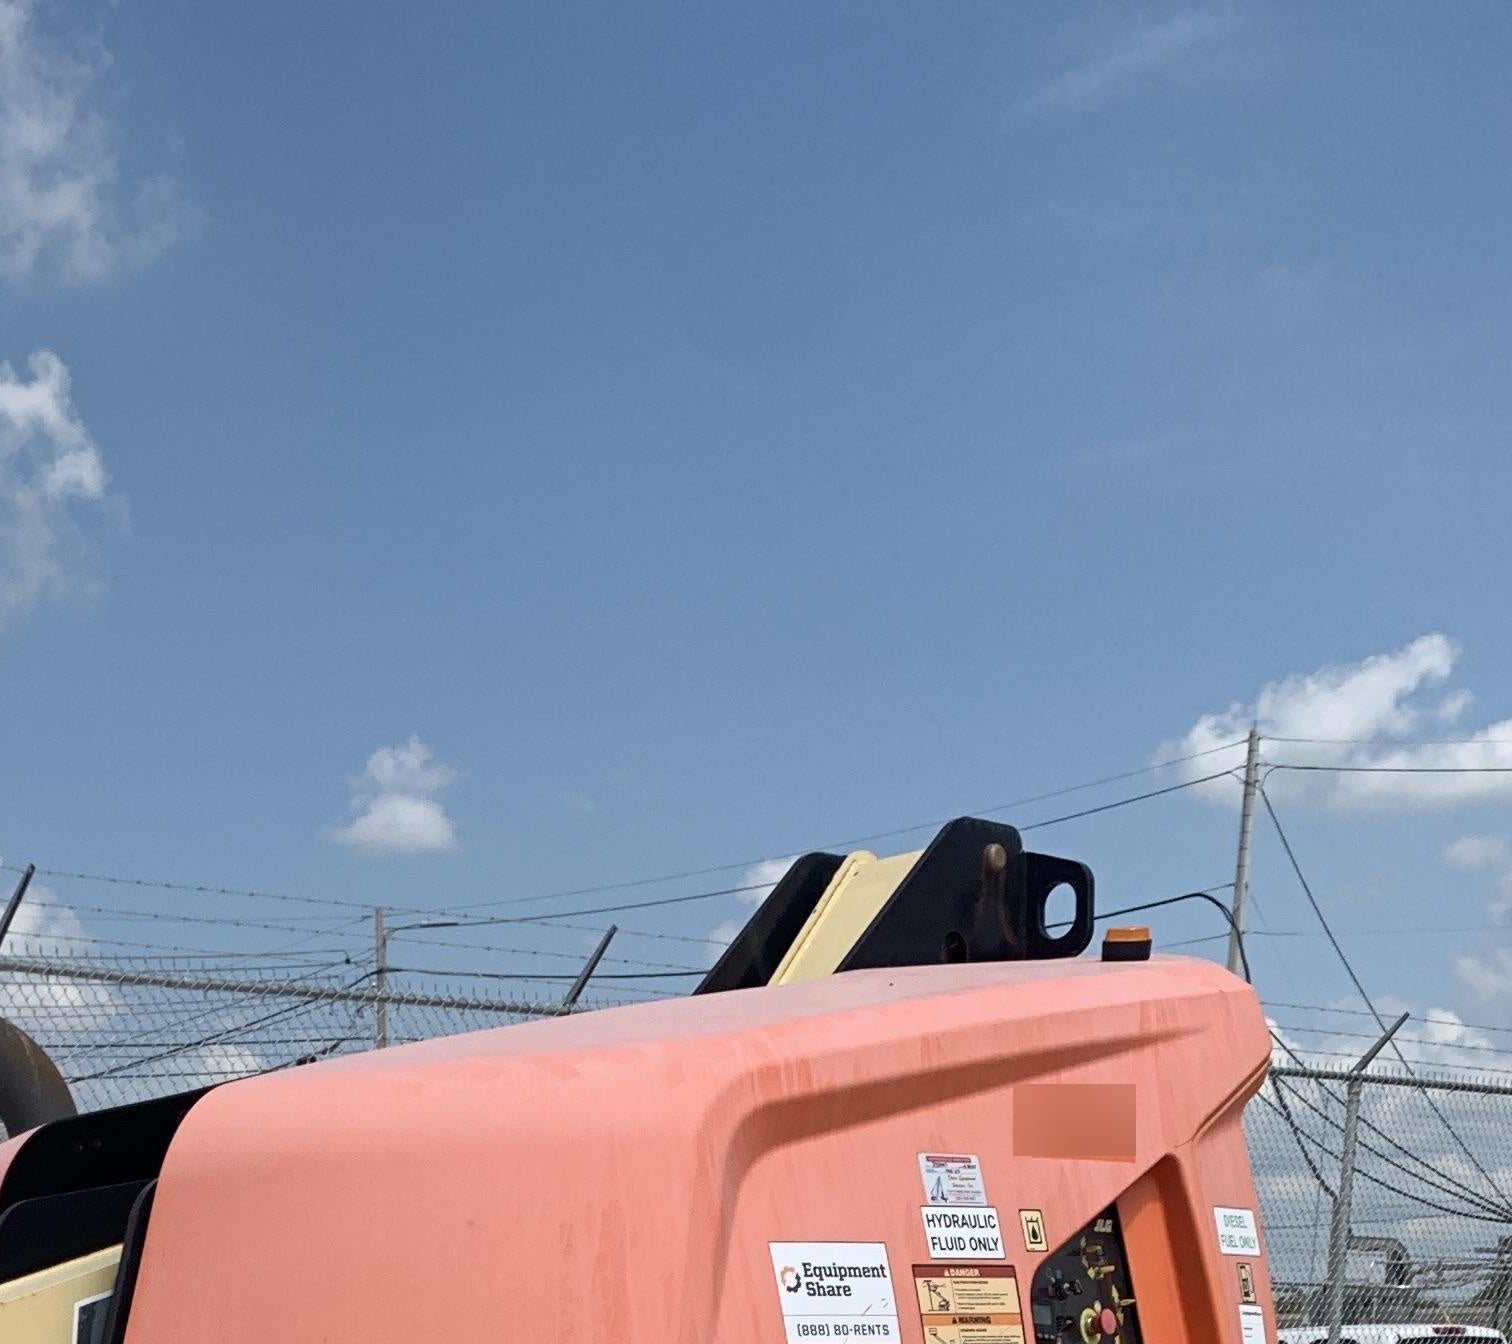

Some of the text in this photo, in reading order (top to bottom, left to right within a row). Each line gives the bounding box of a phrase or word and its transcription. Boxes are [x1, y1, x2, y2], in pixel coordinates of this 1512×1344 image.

[926, 1213, 996, 1229] HYDRAULIC
[1223, 1214, 1248, 1229] DIESEL
[930, 1236, 999, 1251] FLUID ONLY
[1220, 1234, 1256, 1249] FUEL ONLY
[801, 1262, 887, 1281] Equipment
[950, 1268, 981, 1277] DANGER
[805, 1281, 852, 1297] Share
[797, 1323, 889, 1337] (888) 80-RENTS
